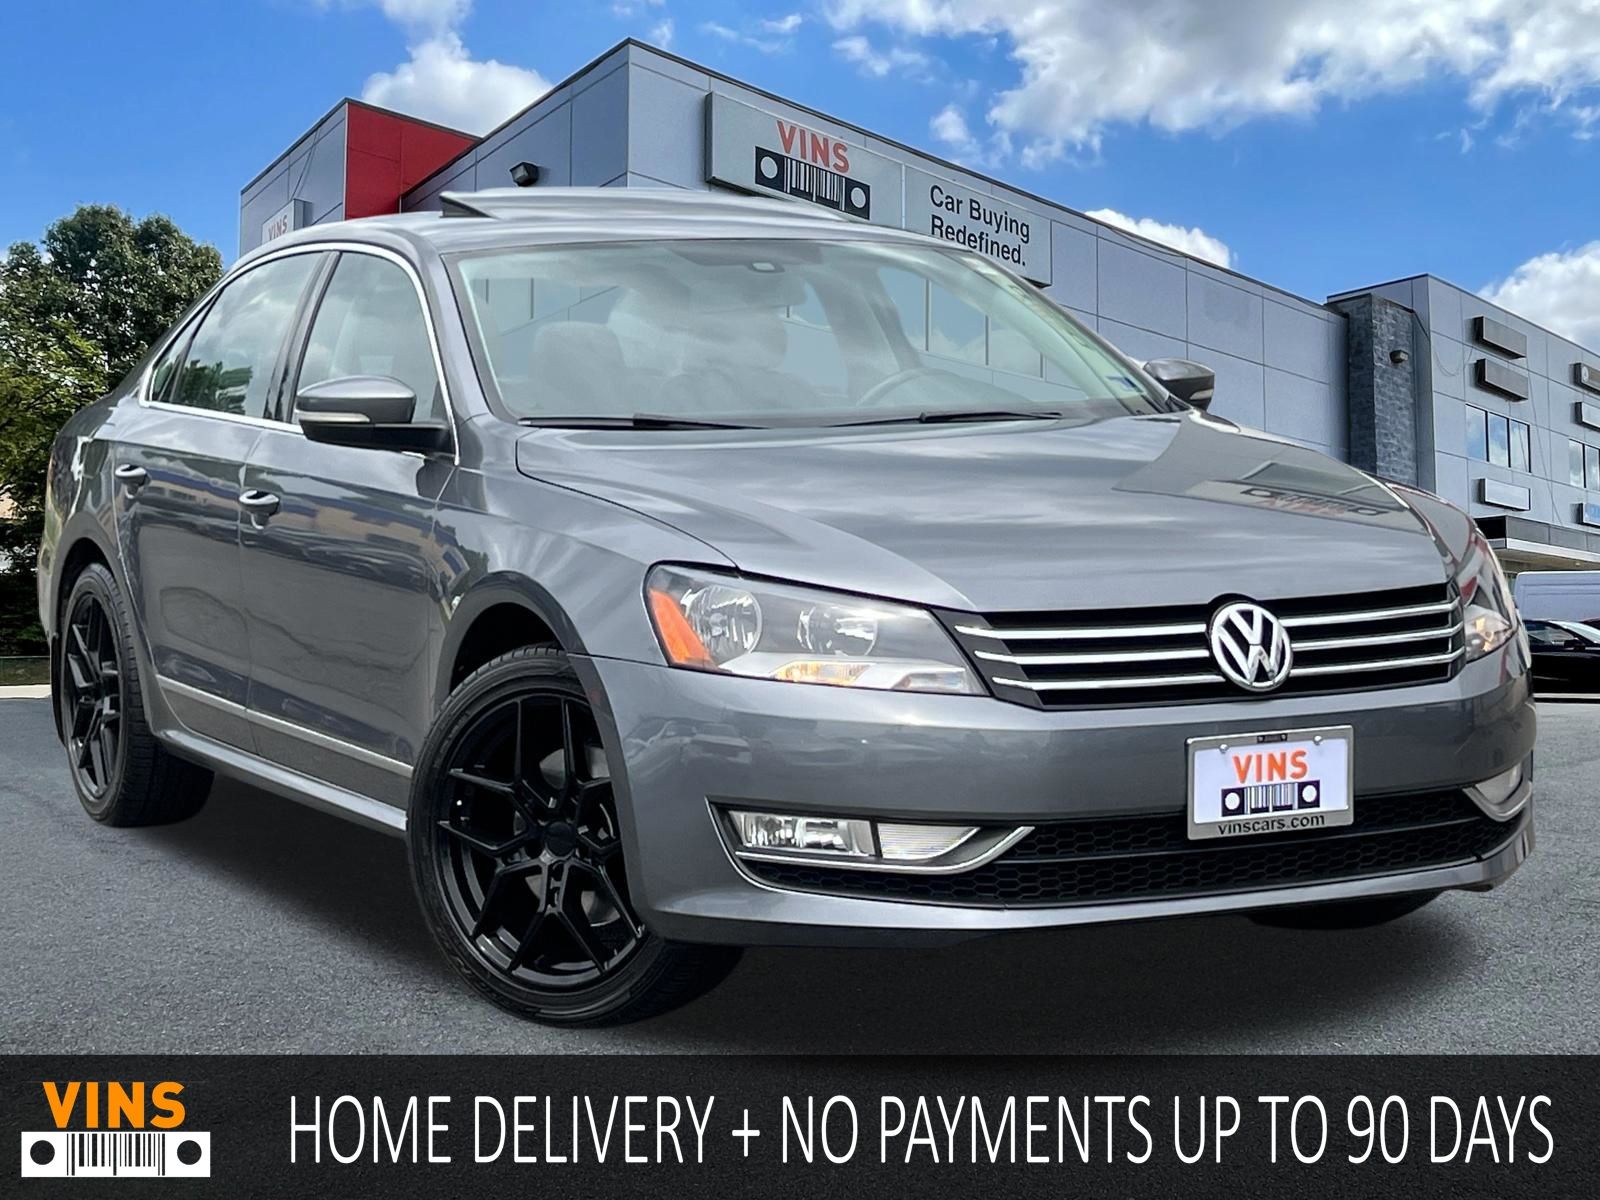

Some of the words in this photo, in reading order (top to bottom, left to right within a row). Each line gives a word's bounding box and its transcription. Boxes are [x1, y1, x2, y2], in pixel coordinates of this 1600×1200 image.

[777, 120, 850, 174] VINS
[267, 214, 289, 241] VINS
[930, 185, 963, 214] Car
[969, 198, 1030, 244] Buying
[931, 214, 1026, 266] Redefined.
[1232, 749, 1308, 784] VINS
[1217, 814, 1326, 835] vinscars.com
